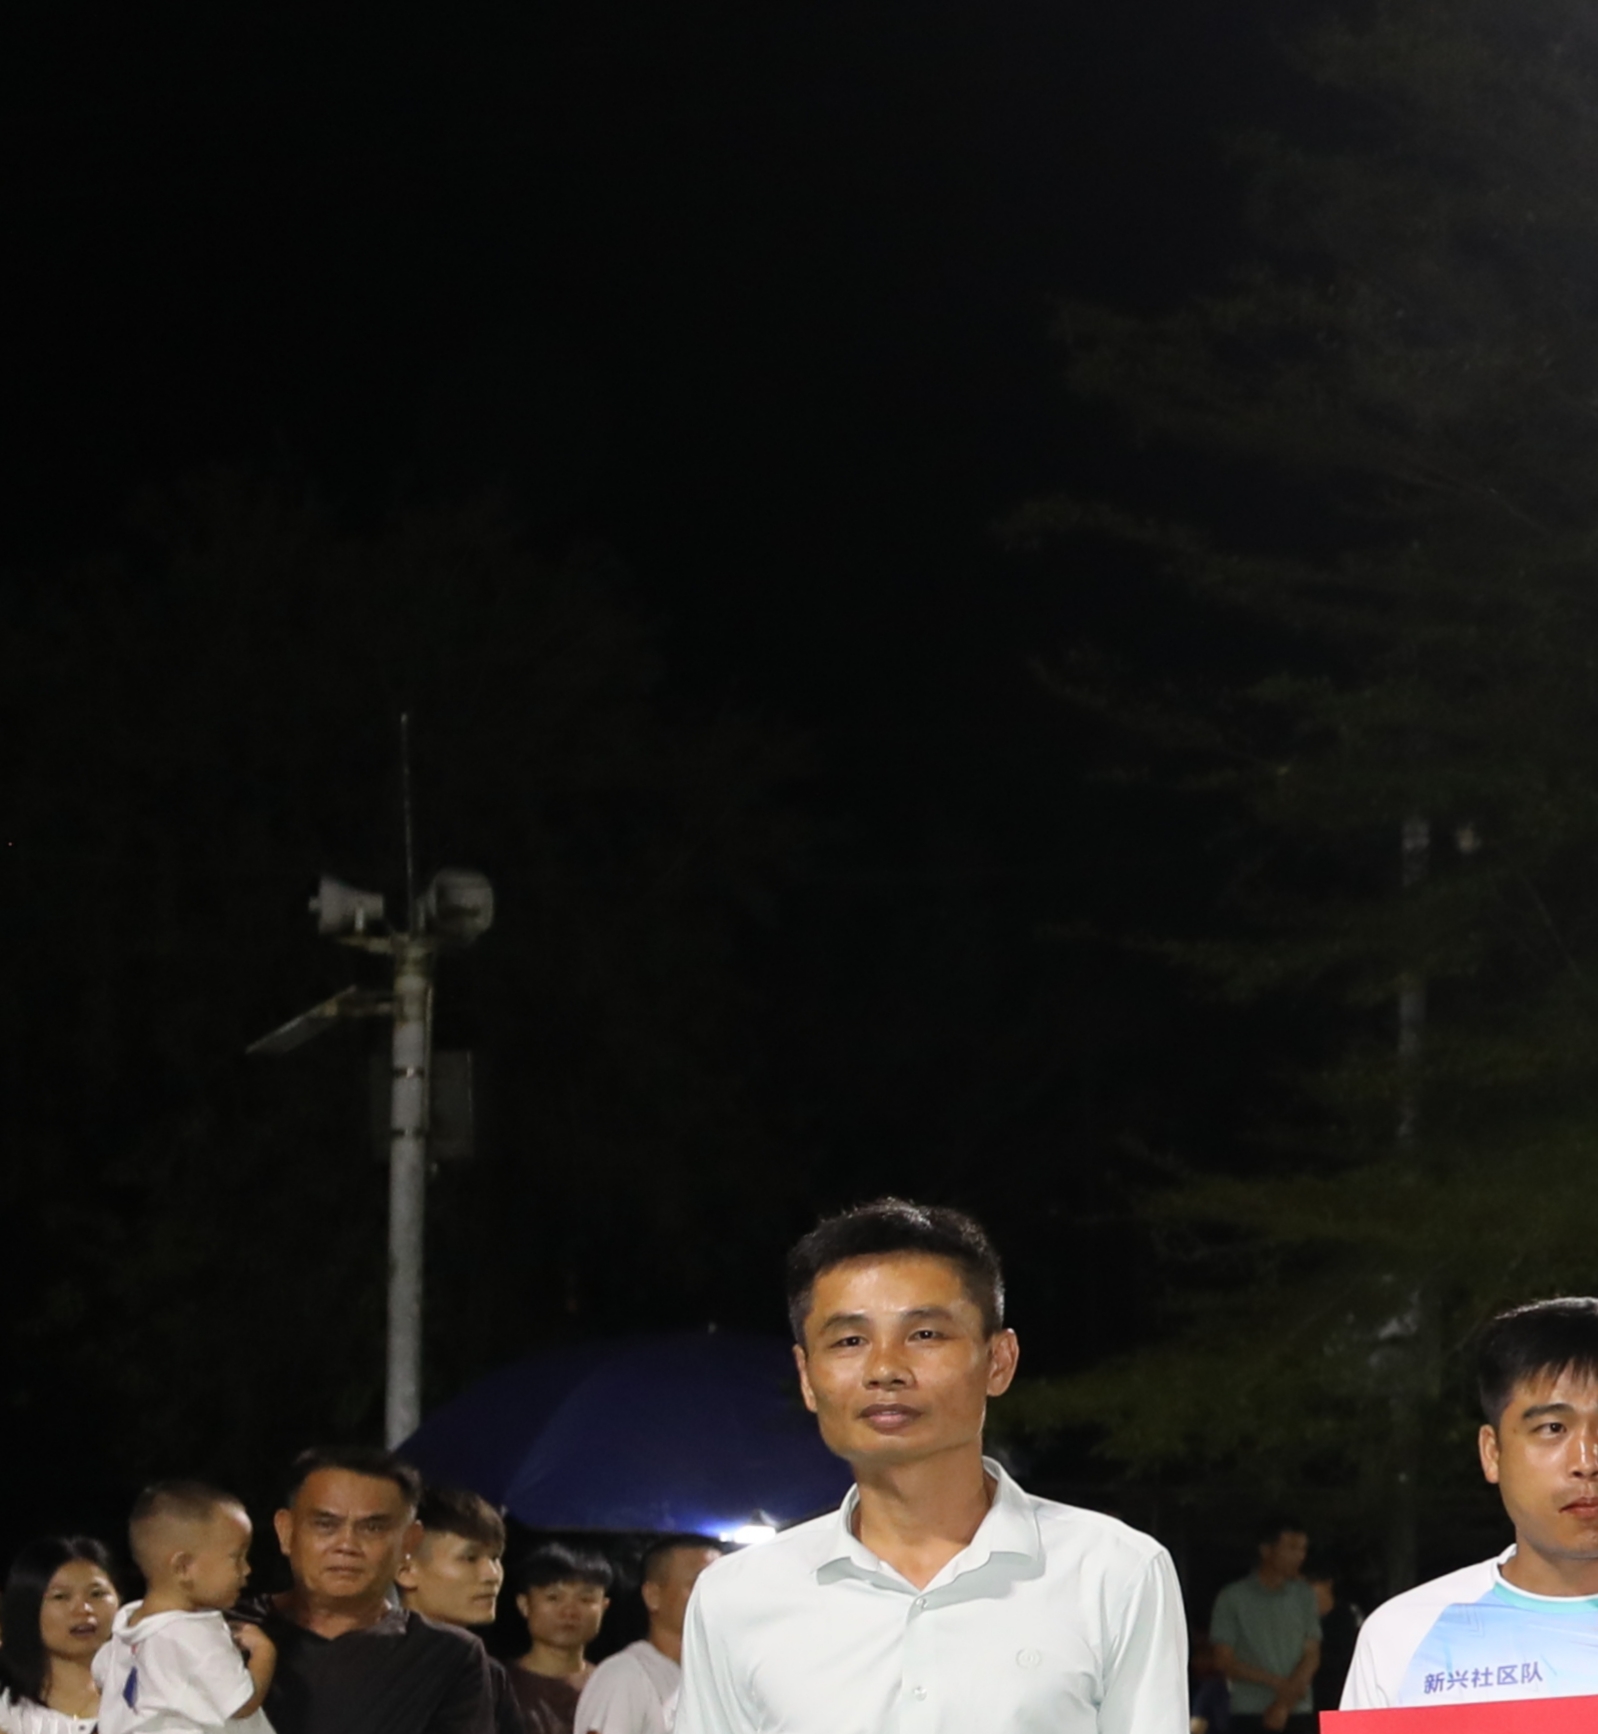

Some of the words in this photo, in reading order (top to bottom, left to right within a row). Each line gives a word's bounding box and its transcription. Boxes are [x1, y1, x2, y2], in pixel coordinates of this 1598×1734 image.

[1423, 1661, 1543, 1694] 新兴社区队
